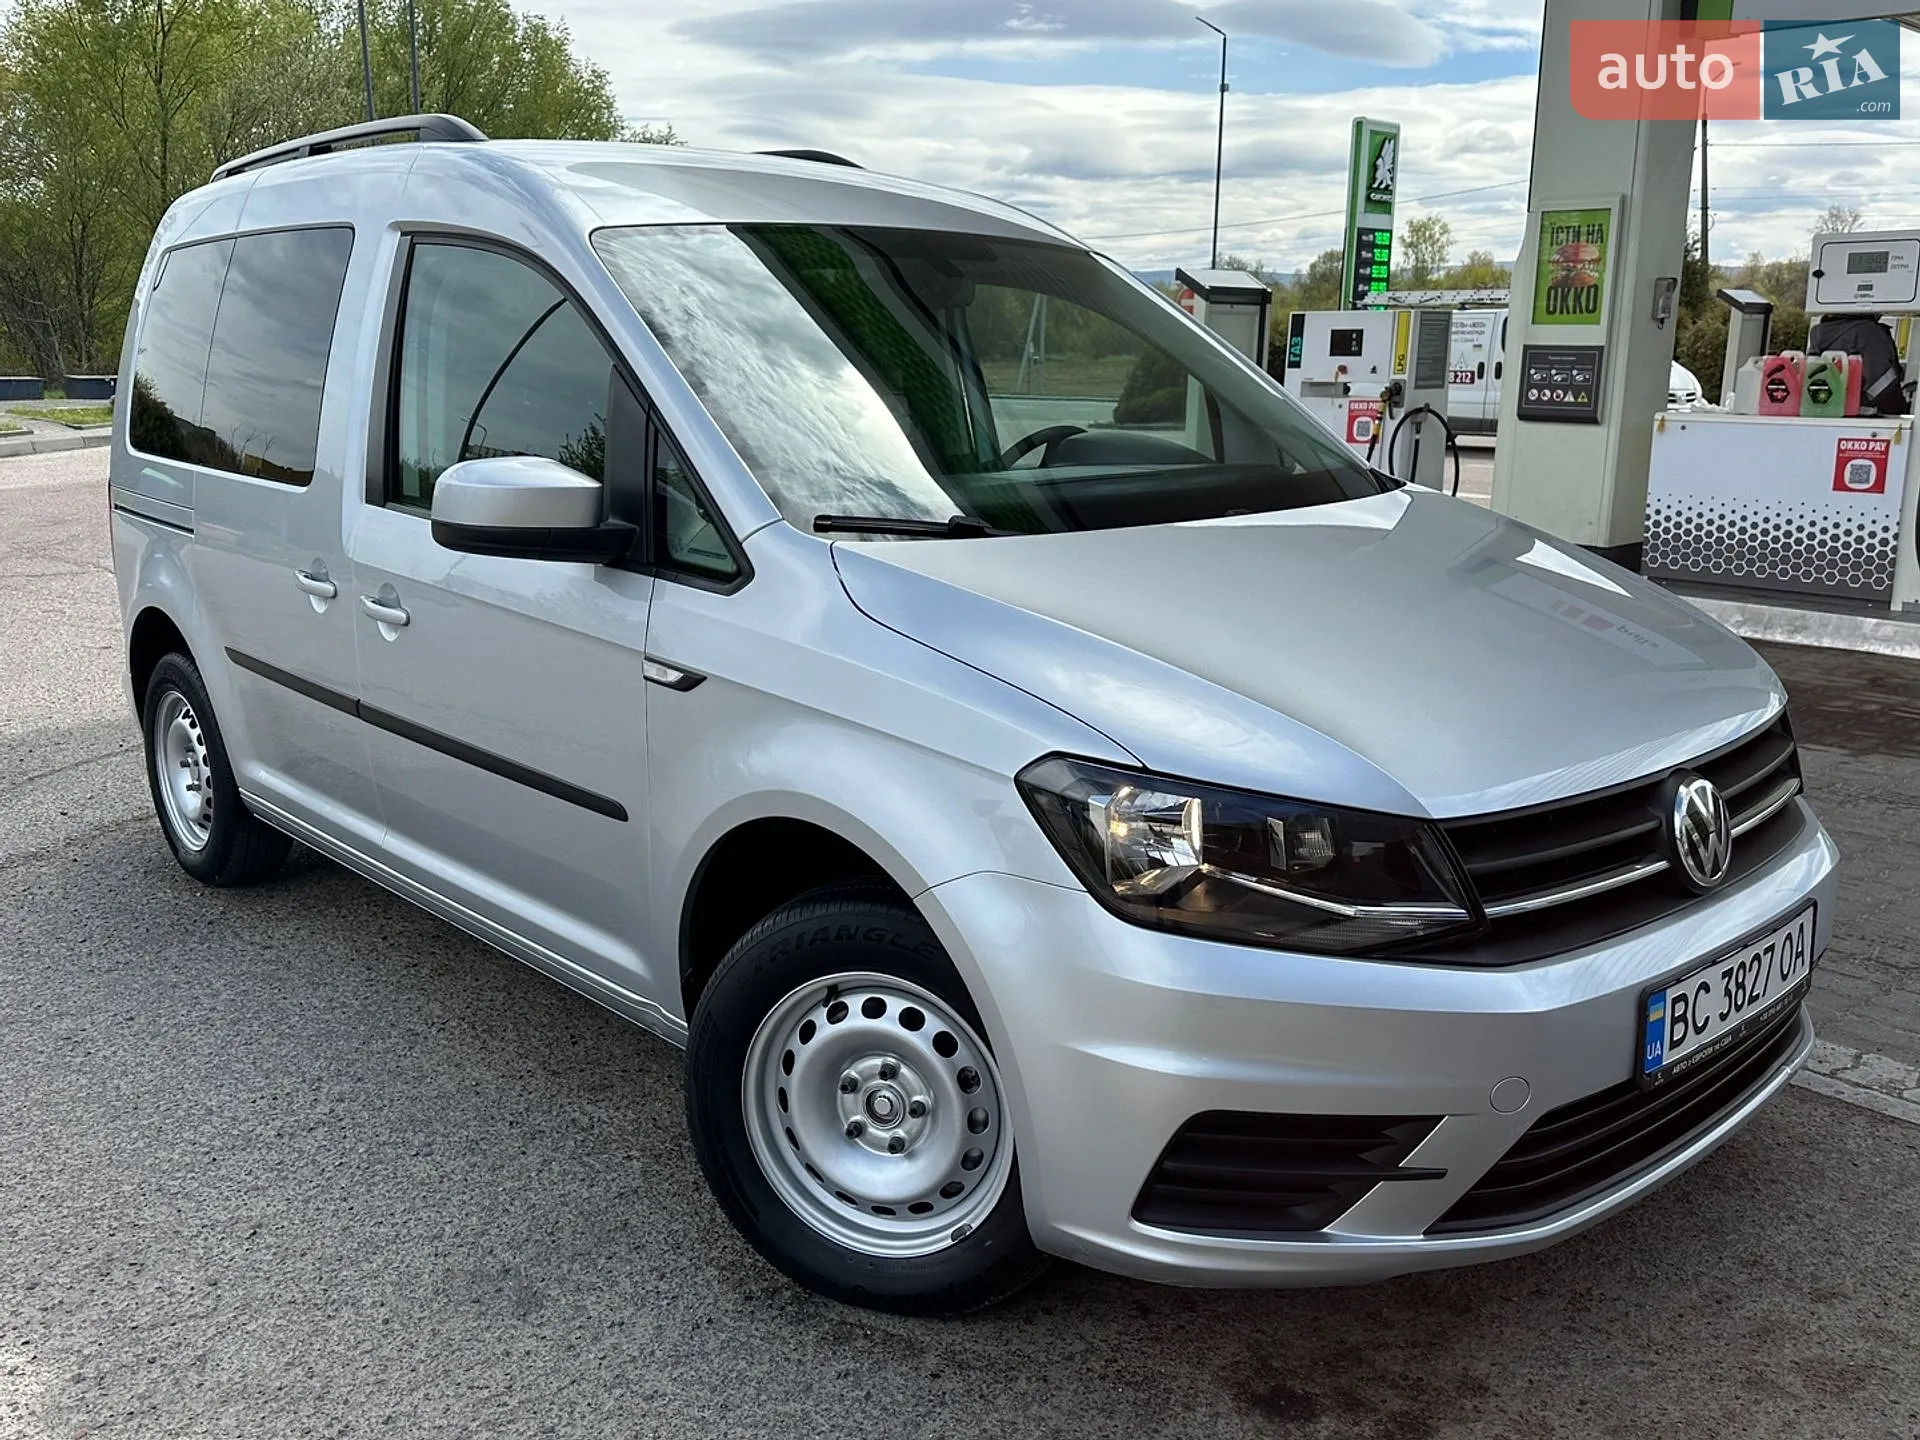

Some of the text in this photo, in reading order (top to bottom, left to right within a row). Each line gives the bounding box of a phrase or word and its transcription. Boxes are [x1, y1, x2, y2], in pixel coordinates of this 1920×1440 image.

[1550, 223, 1604, 247] ЇСТИ НА
[1290, 336, 1301, 361] ГАЗ
[1397, 354, 1405, 372] LPG
[1868, 441, 1887, 451] PAY
[753, 924, 938, 974] TRIANGLE
[1718, 942, 1776, 1022] 3827
[1646, 1042, 1662, 1060] UA
